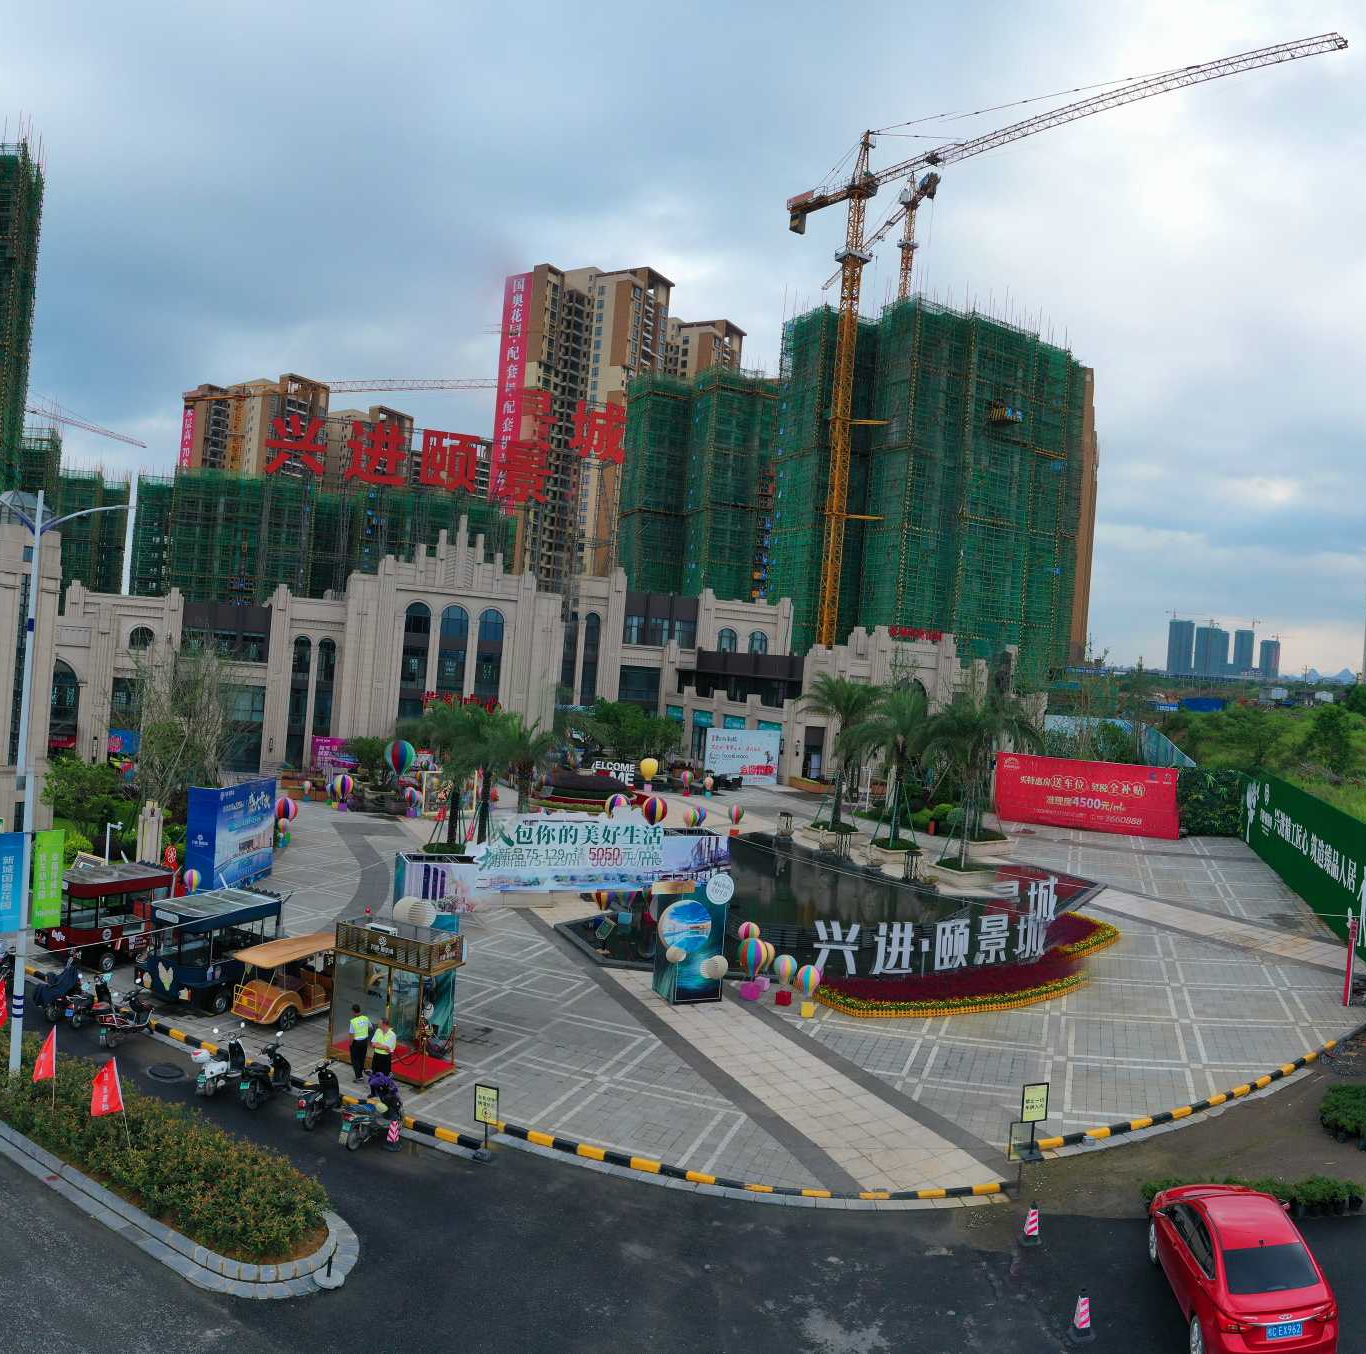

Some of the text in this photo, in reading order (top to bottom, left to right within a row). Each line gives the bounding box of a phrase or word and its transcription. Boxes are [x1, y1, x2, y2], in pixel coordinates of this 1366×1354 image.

[1273, 807, 1309, 856] 兴进精工匠心
